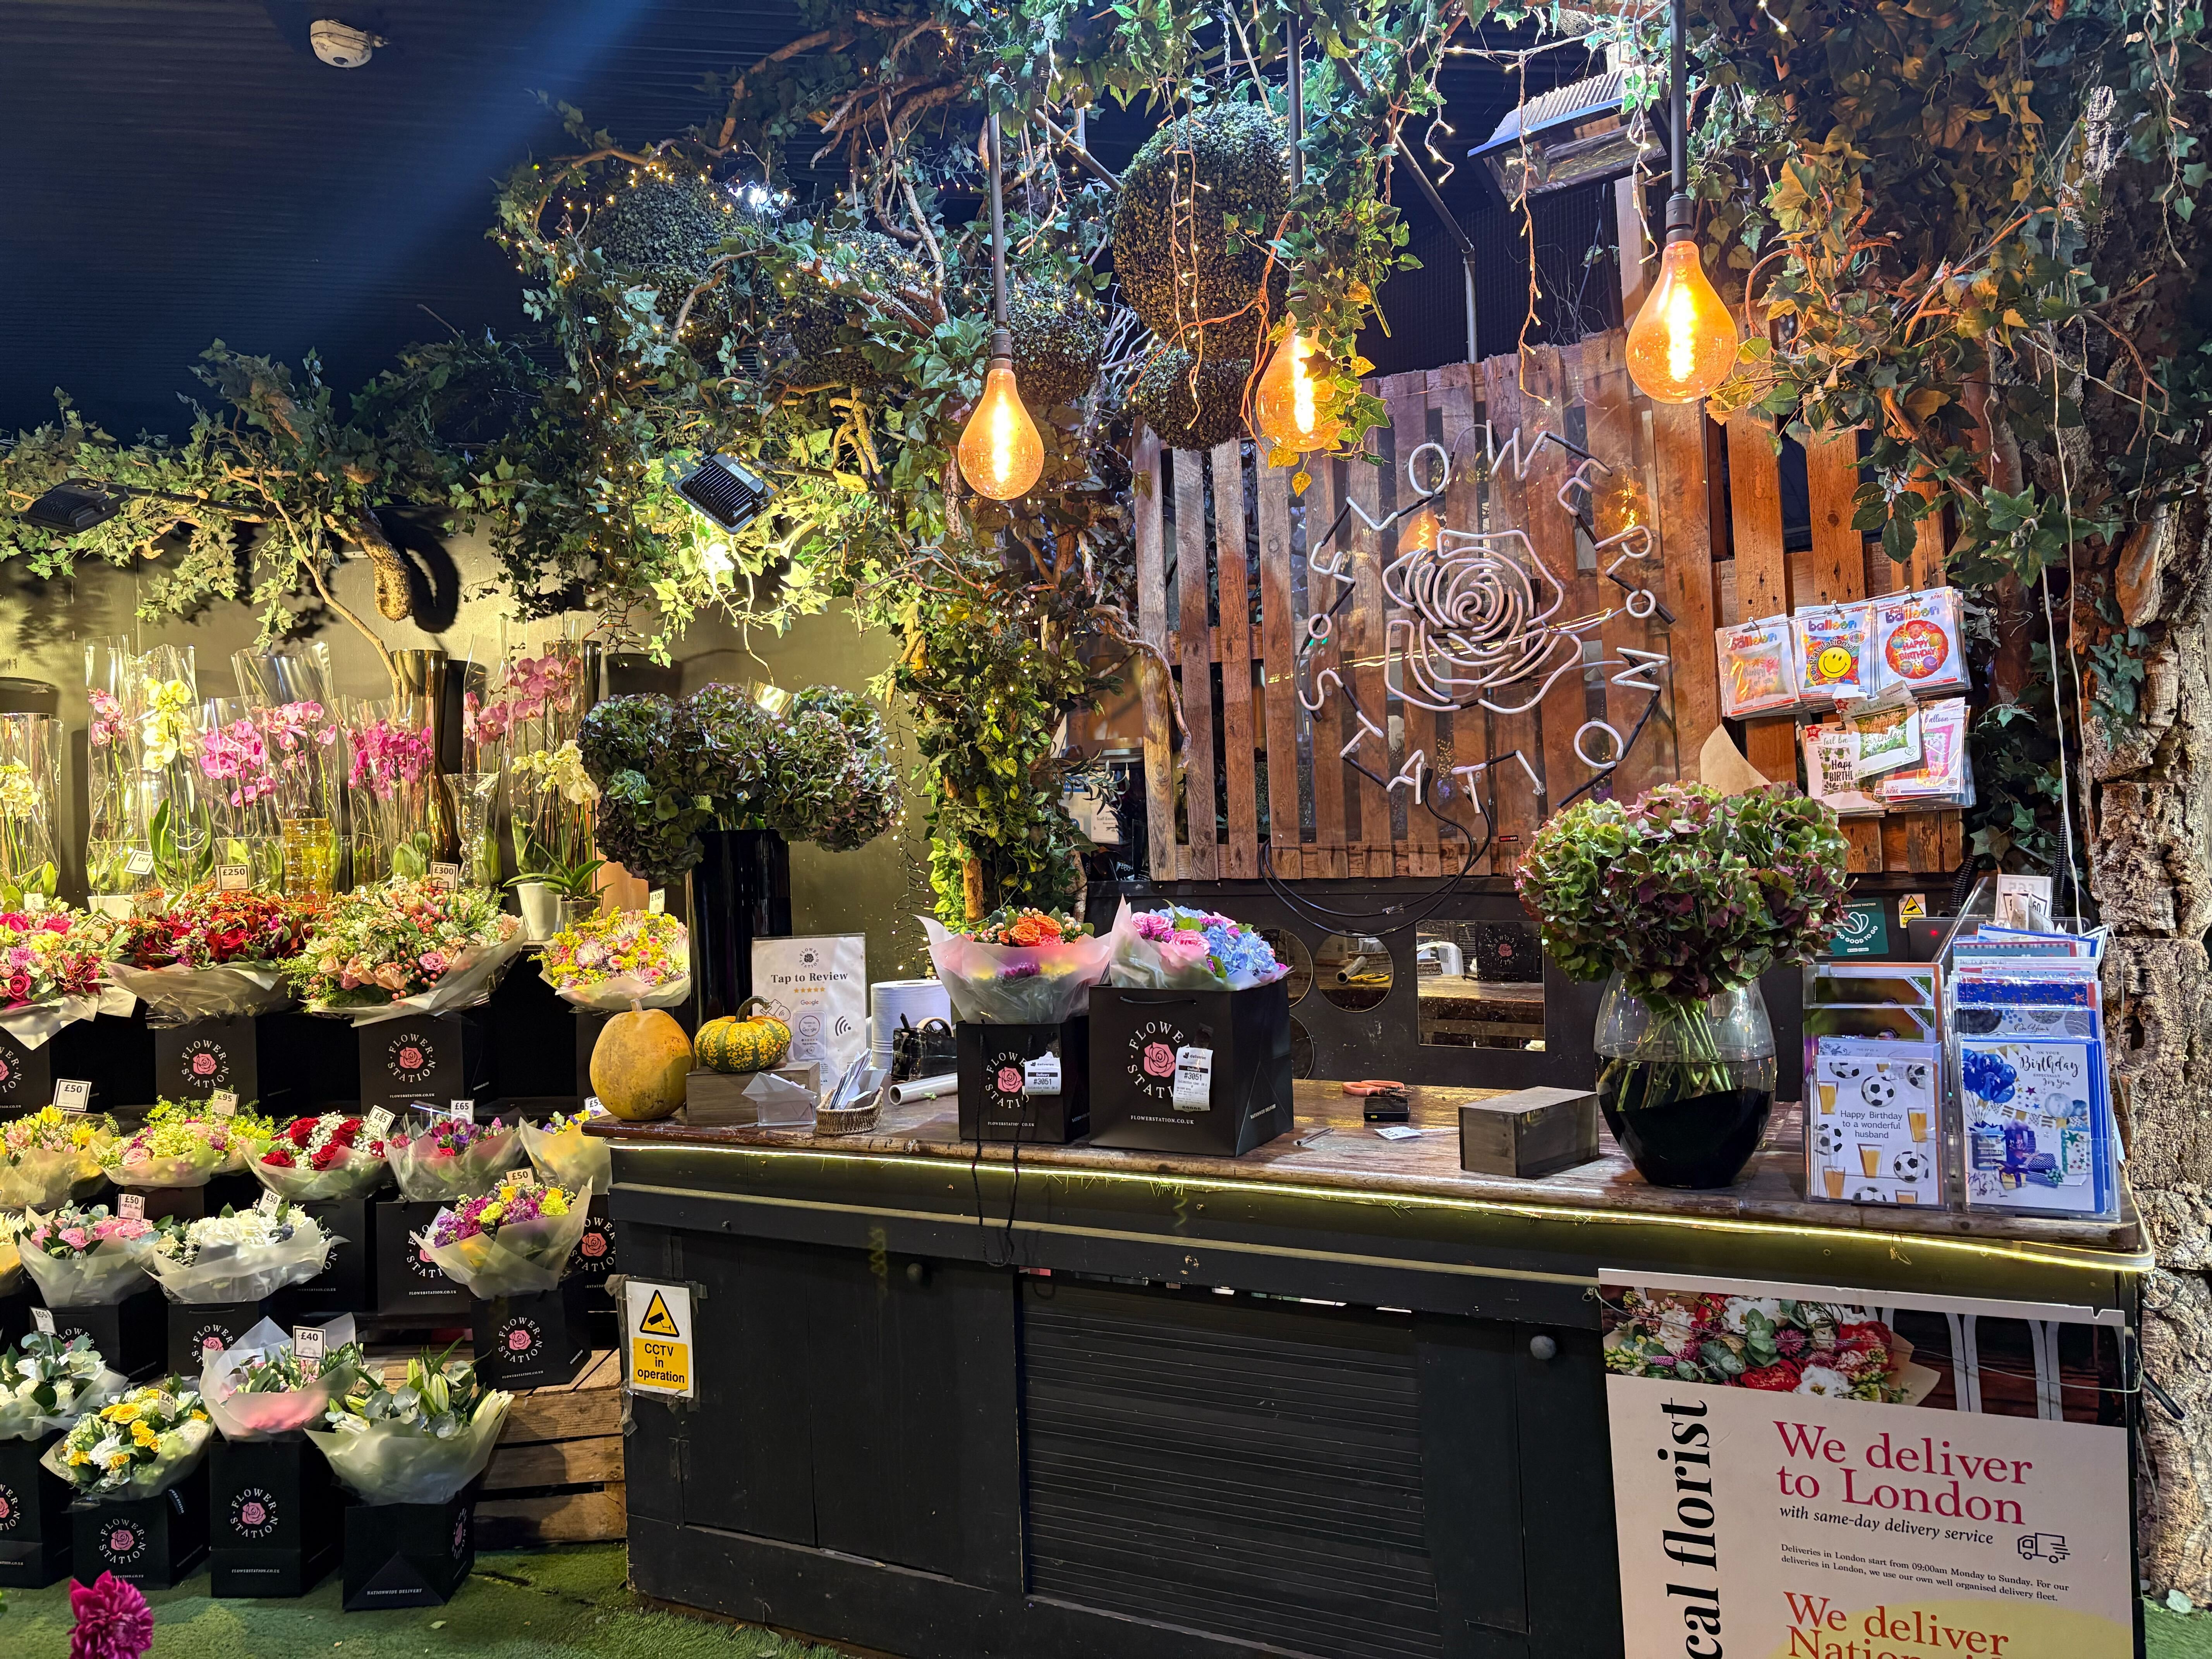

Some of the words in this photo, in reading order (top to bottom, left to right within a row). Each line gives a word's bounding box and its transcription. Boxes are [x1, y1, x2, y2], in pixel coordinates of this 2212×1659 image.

[1310, 419, 1654, 584] FLOWER
[1886, 606, 1939, 623] balloon
[1808, 620, 1856, 632] balloon
[1899, 648, 1936, 660] BIRTHDAY
[1902, 639, 1929, 651] HAPPY
[1298, 647, 1669, 813] STATION
[434, 867, 453, 875] £300
[651, 892, 663, 901] £100
[1870, 926, 1878, 934] GO
[800, 948, 819, 957] FLOWER
[799, 958, 819, 968] STATION
[771, 974, 791, 984] Tap
[795, 974, 805, 982] to
[809, 972, 848, 981] Review
[389, 1033, 433, 1054] FLOWER
[1129, 1021, 1190, 1051] FLOWE
[182, 1039, 227, 1060] FLOWER
[388, 1060, 436, 1082] STATION
[986, 1051, 1027, 1073] FLOWE
[2019, 1055, 2080, 1078] Birthday
[182, 1066, 230, 1088] STATION
[1127, 1064, 1173, 1098] STATI
[1184, 1072, 1202, 1081] #3051
[64, 1084, 82, 1093] £50
[985, 1084, 1029, 1108] STATIO
[589, 1099, 601, 1108] £5
[1130, 1115, 1194, 1125] FLOWERSTATION.CO.UK
[1841, 1110, 1865, 1120] Happy
[1869, 1111, 1902, 1121] Birthday
[1855, 1130, 1889, 1139] husband
[512, 1171, 528, 1180] £50
[125, 1196, 139, 1204] £50
[266, 1193, 278, 1204] £50
[407, 1255, 443, 1278] STATI
[193, 1324, 233, 1343] FLOWER
[301, 1332, 318, 1341] £40
[499, 1317, 540, 1338] FLOWER
[498, 1340, 543, 1363] STATION
[644, 1343, 674, 1357] CCTV
[655, 1357, 664, 1368] in
[637, 1369, 685, 1383] operation
[161, 1394, 173, 1405] £45
[1773, 1420, 1846, 1463] We
[1866, 1433, 2032, 1484] deliver
[1657, 1397, 1717, 1571] florist
[232, 1488, 276, 1510] FLOWER
[1776, 1465, 1820, 1499] to
[1839, 1467, 2026, 1525] London
[101, 1518, 144, 1536] FLOWER
[230, 1516, 278, 1538] STATION
[1780, 1506, 1808, 1519] with
[1814, 1513, 1880, 1532] same-day
[1885, 1518, 1940, 1540] delivery
[1945, 1528, 1994, 1544] service
[99, 1542, 146, 1564] STATION
[1781, 1544, 1821, 1556] Deliveries
[1824, 1550, 1832, 1558] in
[1835, 1551, 1866, 1563] London
[1869, 1557, 1887, 1566] start
[1890, 1559, 1909, 1569] from
[1912, 1563, 1947, 1575] 09:00am
[1951, 1568, 1984, 1581] Monday
[1999, 1575, 2033, 1587] Sunday.
[2037, 1580, 2051, 1589] For
[1781, 1555, 1819, 1567] deliveries
[1833, 1563, 1867, 1575] London,
[1956, 1581, 1996, 1593] organised
[1999, 1587, 2033, 1599] delivery
[2036, 1591, 2058, 1601] fleet.
[1783, 1591, 1847, 1632] We
[1864, 1605, 2009, 1656] deliver
